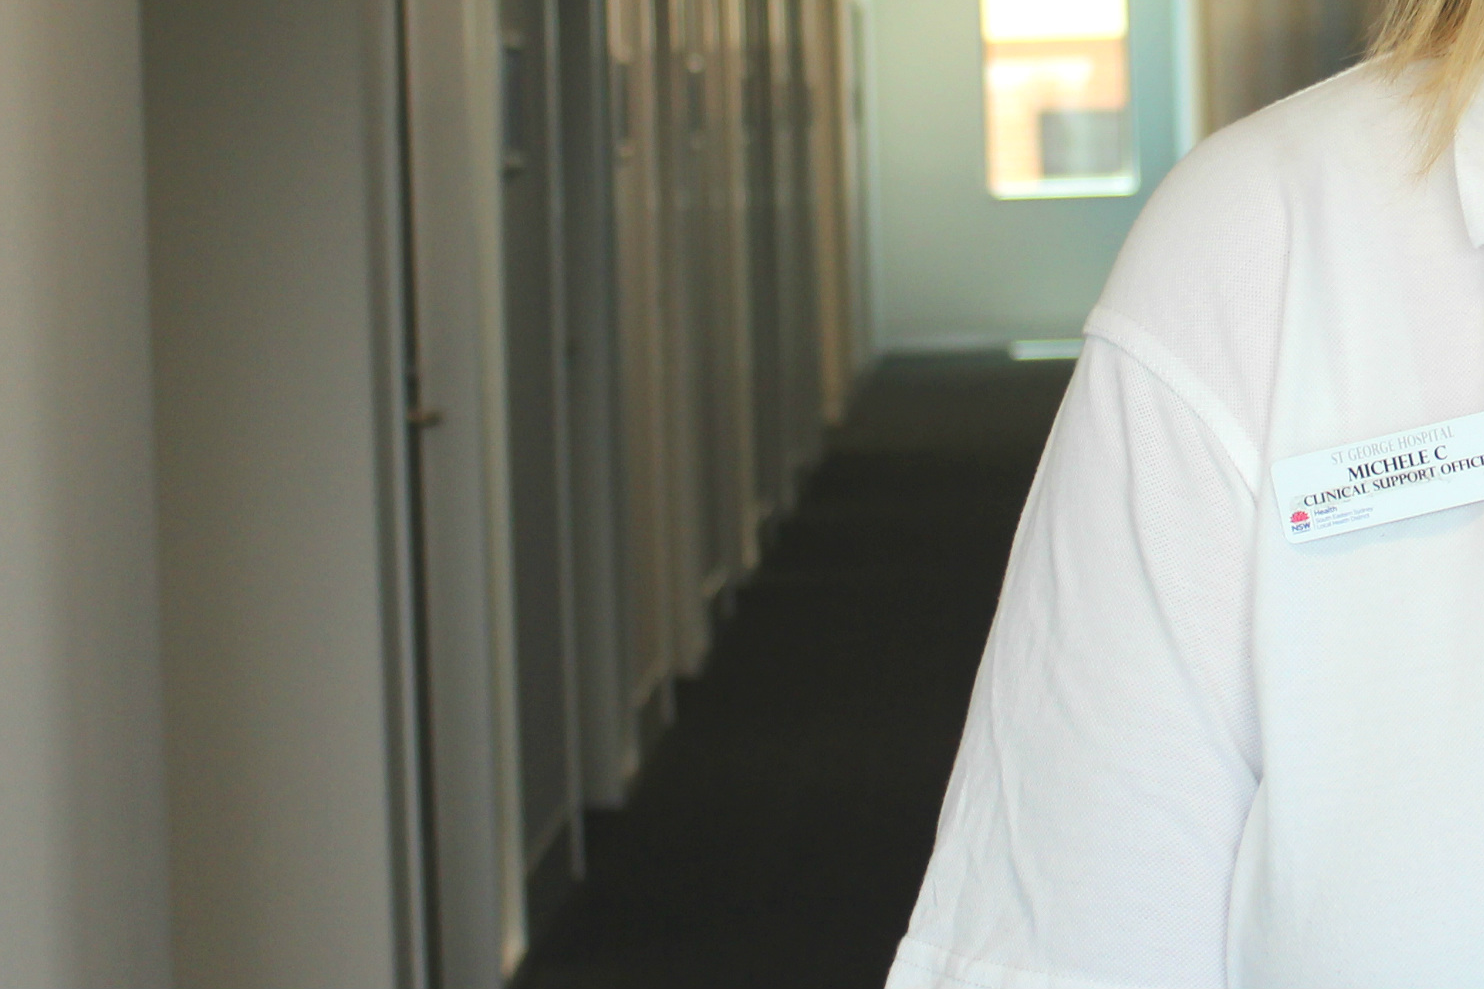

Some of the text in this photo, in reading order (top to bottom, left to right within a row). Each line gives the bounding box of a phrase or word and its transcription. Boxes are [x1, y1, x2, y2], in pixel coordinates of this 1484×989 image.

[1331, 426, 1455, 465] ST GEORGE HOSPITAL
[1347, 445, 1448, 481] MICHELE C
[1303, 483, 1369, 507] CLINICAL
[1373, 467, 1437, 491] SUPPORT
[1291, 522, 1310, 532] NSW
[1314, 506, 1337, 516] Health
